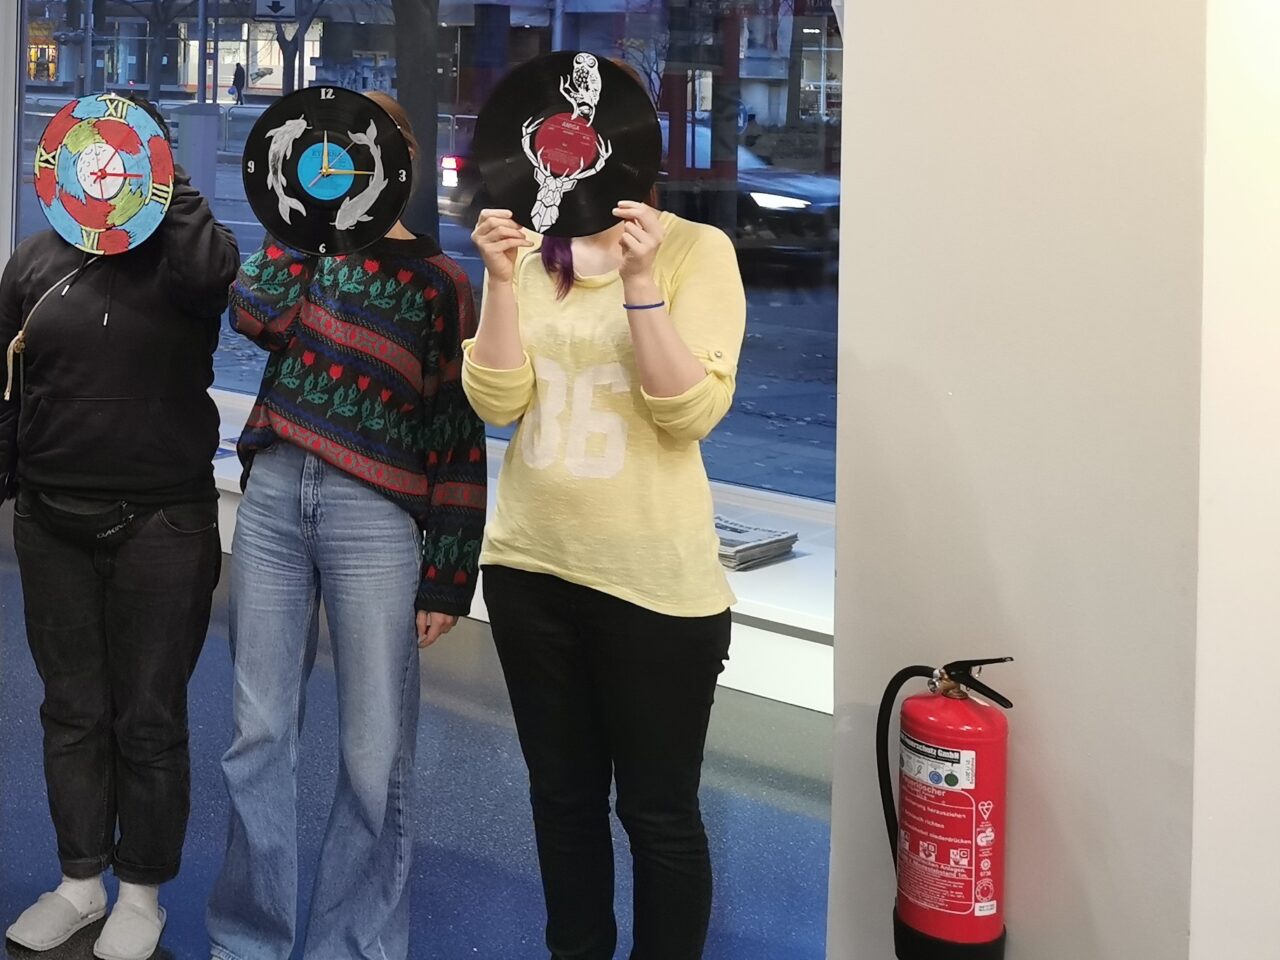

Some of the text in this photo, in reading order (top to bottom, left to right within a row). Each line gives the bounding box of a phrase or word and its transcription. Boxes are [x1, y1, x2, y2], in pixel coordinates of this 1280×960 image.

[320, 88, 335, 100] 12
[247, 160, 255, 173] 9
[398, 170, 407, 182] 3
[319, 243, 326, 253] 6
[937, 748, 960, 760] GmbH
[924, 818, 945, 829] richten
